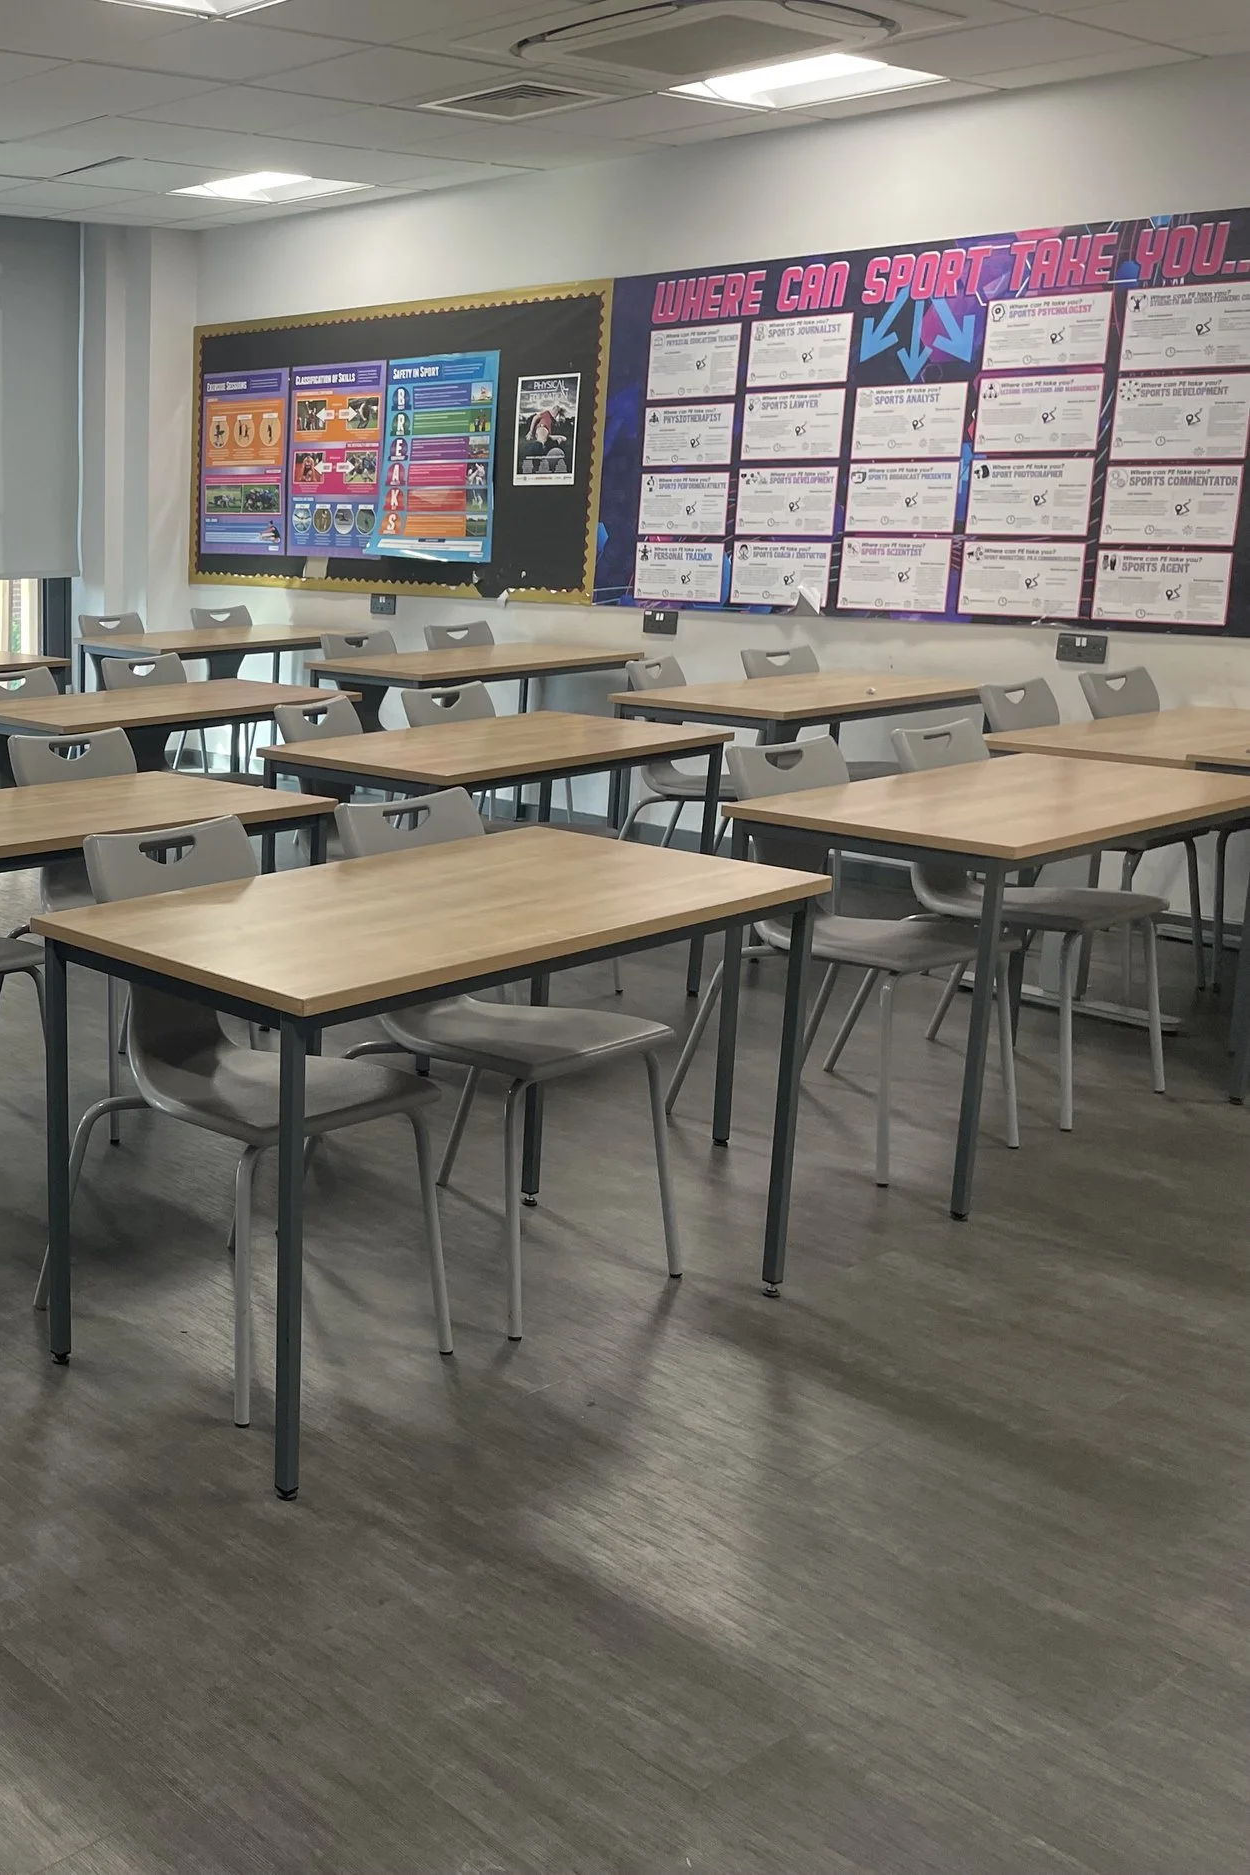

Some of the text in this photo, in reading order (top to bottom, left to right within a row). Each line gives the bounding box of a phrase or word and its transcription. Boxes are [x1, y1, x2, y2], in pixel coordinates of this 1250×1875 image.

[651, 269, 767, 324] WHERE
[776, 261, 850, 313] CAN
[861, 245, 993, 306] SPORT
[1010, 231, 1119, 292] TAKE
[1009, 304, 1092, 318] SPORTS PSYCHOLOGIST
[768, 324, 840, 338] SPORTS JOURNALIST
[534, 380, 565, 390] PHYSICAL
[397, 388, 405, 405] B
[1141, 386, 1228, 397] SPORTS DEVELOPMENT
[762, 400, 818, 410] SPORTS LAWYER
[875, 394, 940, 405] SPORTS ANALYST
[397, 414, 405, 431] R
[664, 413, 721, 423] PHYSIOTHERAPIST
[395, 439, 403, 456] E
[391, 464, 400, 482] A
[1014, 470, 1062, 478] PHOTOGRAPHER
[793, 476, 834, 484] DEVELOPMENT
[1129, 476, 1238, 486] SPORTS COMMENTATOR
[391, 489, 400, 506] K
[387, 514, 396, 530] S
[654, 552, 683, 560] PERSONAL
[1122, 563, 1190, 573] SPORTS AGENT
